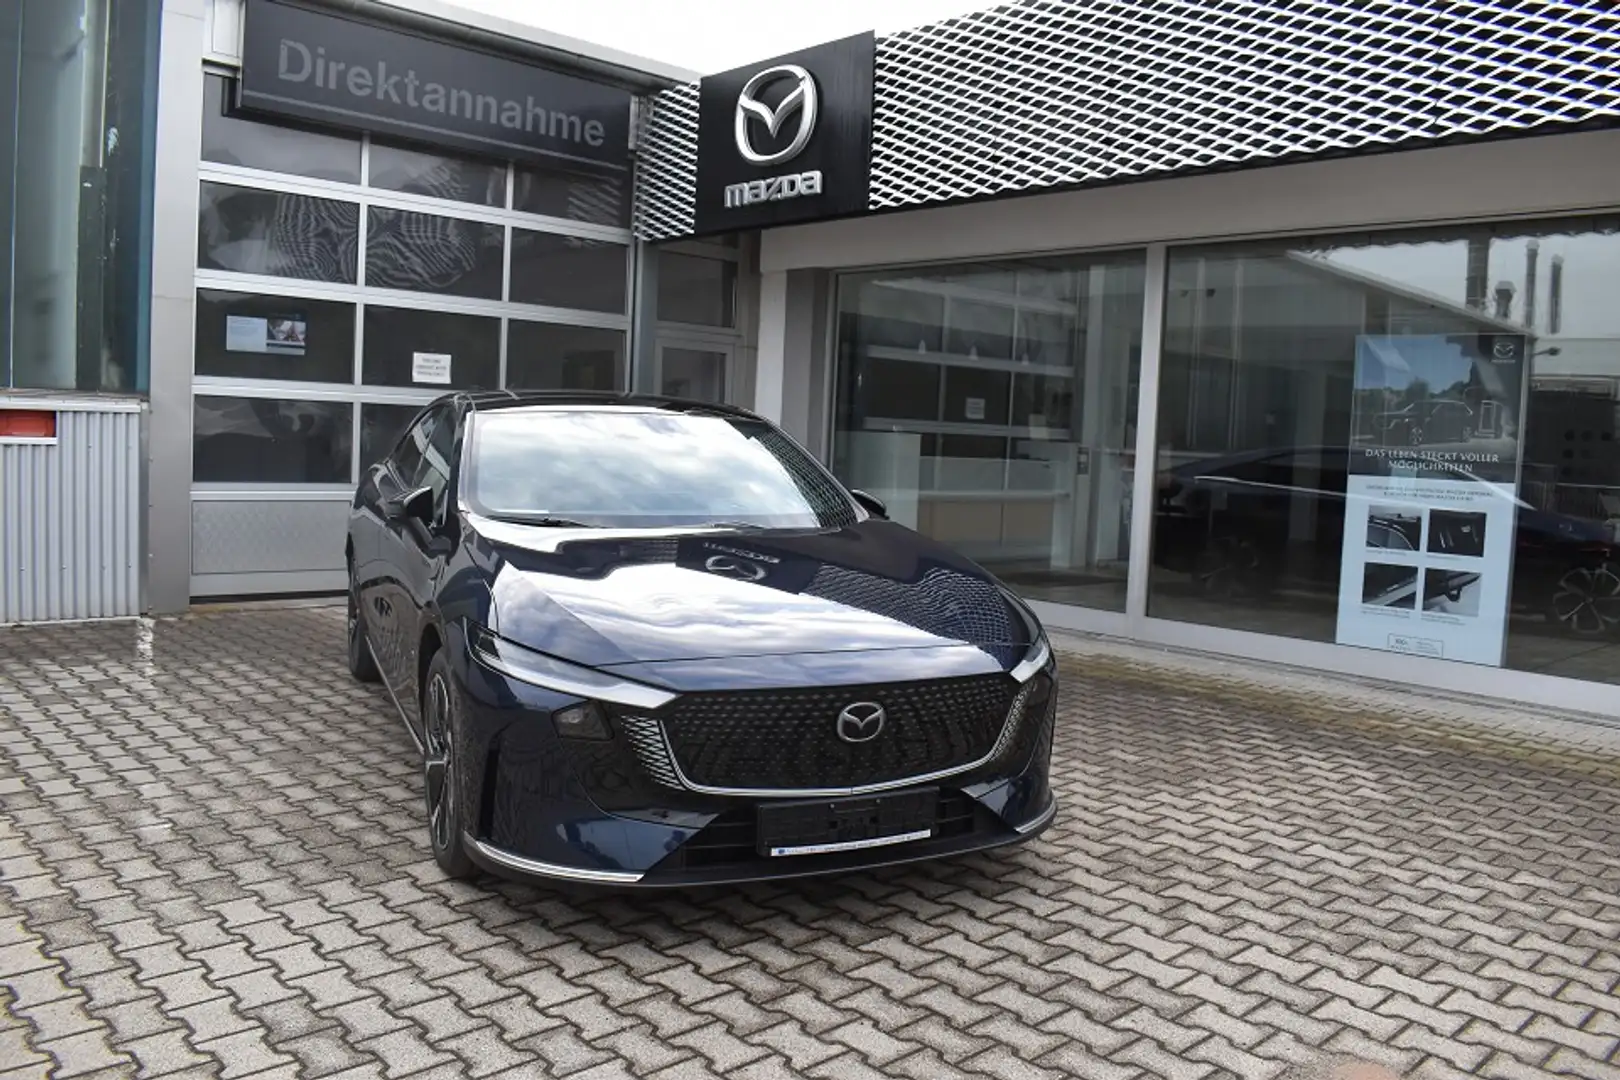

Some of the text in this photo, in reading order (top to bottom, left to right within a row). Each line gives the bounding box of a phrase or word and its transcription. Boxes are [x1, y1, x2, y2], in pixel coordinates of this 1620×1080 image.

[278, 37, 606, 147] Direktannahme
[1365, 449, 1386, 458] DAS
[1460, 452, 1499, 463] VOLLER
